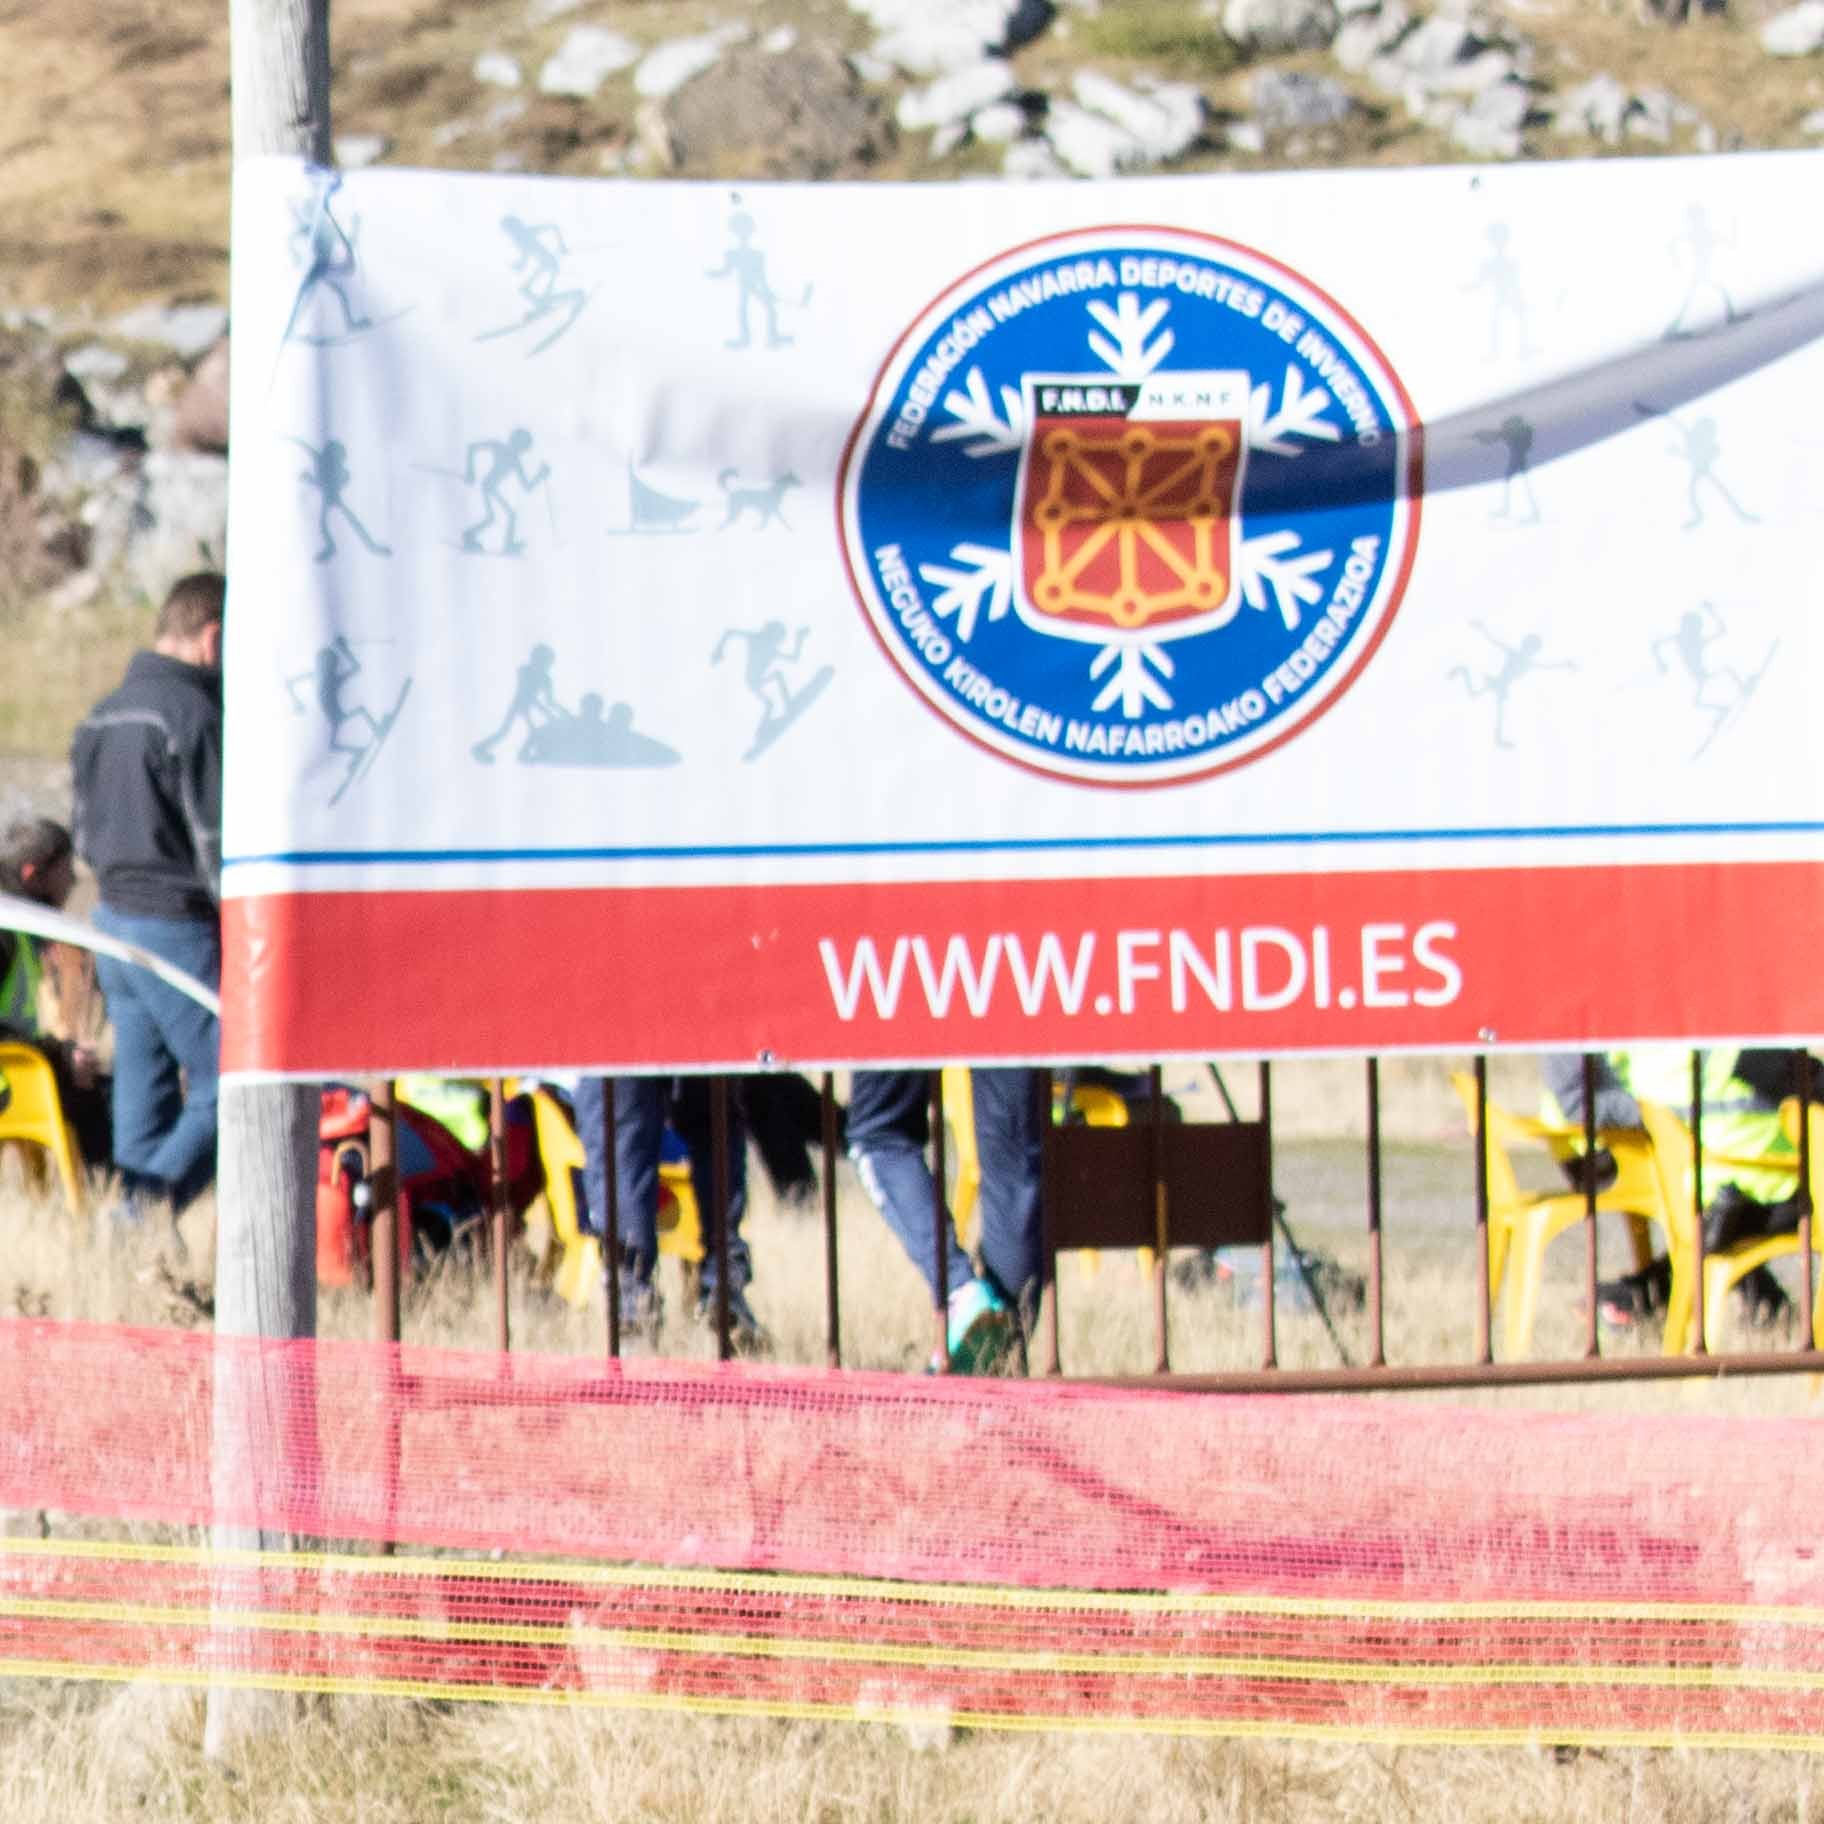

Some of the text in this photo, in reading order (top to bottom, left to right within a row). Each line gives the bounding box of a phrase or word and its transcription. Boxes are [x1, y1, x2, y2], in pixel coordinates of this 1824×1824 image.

[886, 256, 1382, 450] FEDERACIÓN NAVARRA DEPORTES DE INVIERNO
[873, 534, 1381, 756] NEGUKO KIROLEN NAFARROAKO FEDERAZIOA
[818, 921, 1463, 1021] WWW.FNDI.ES
